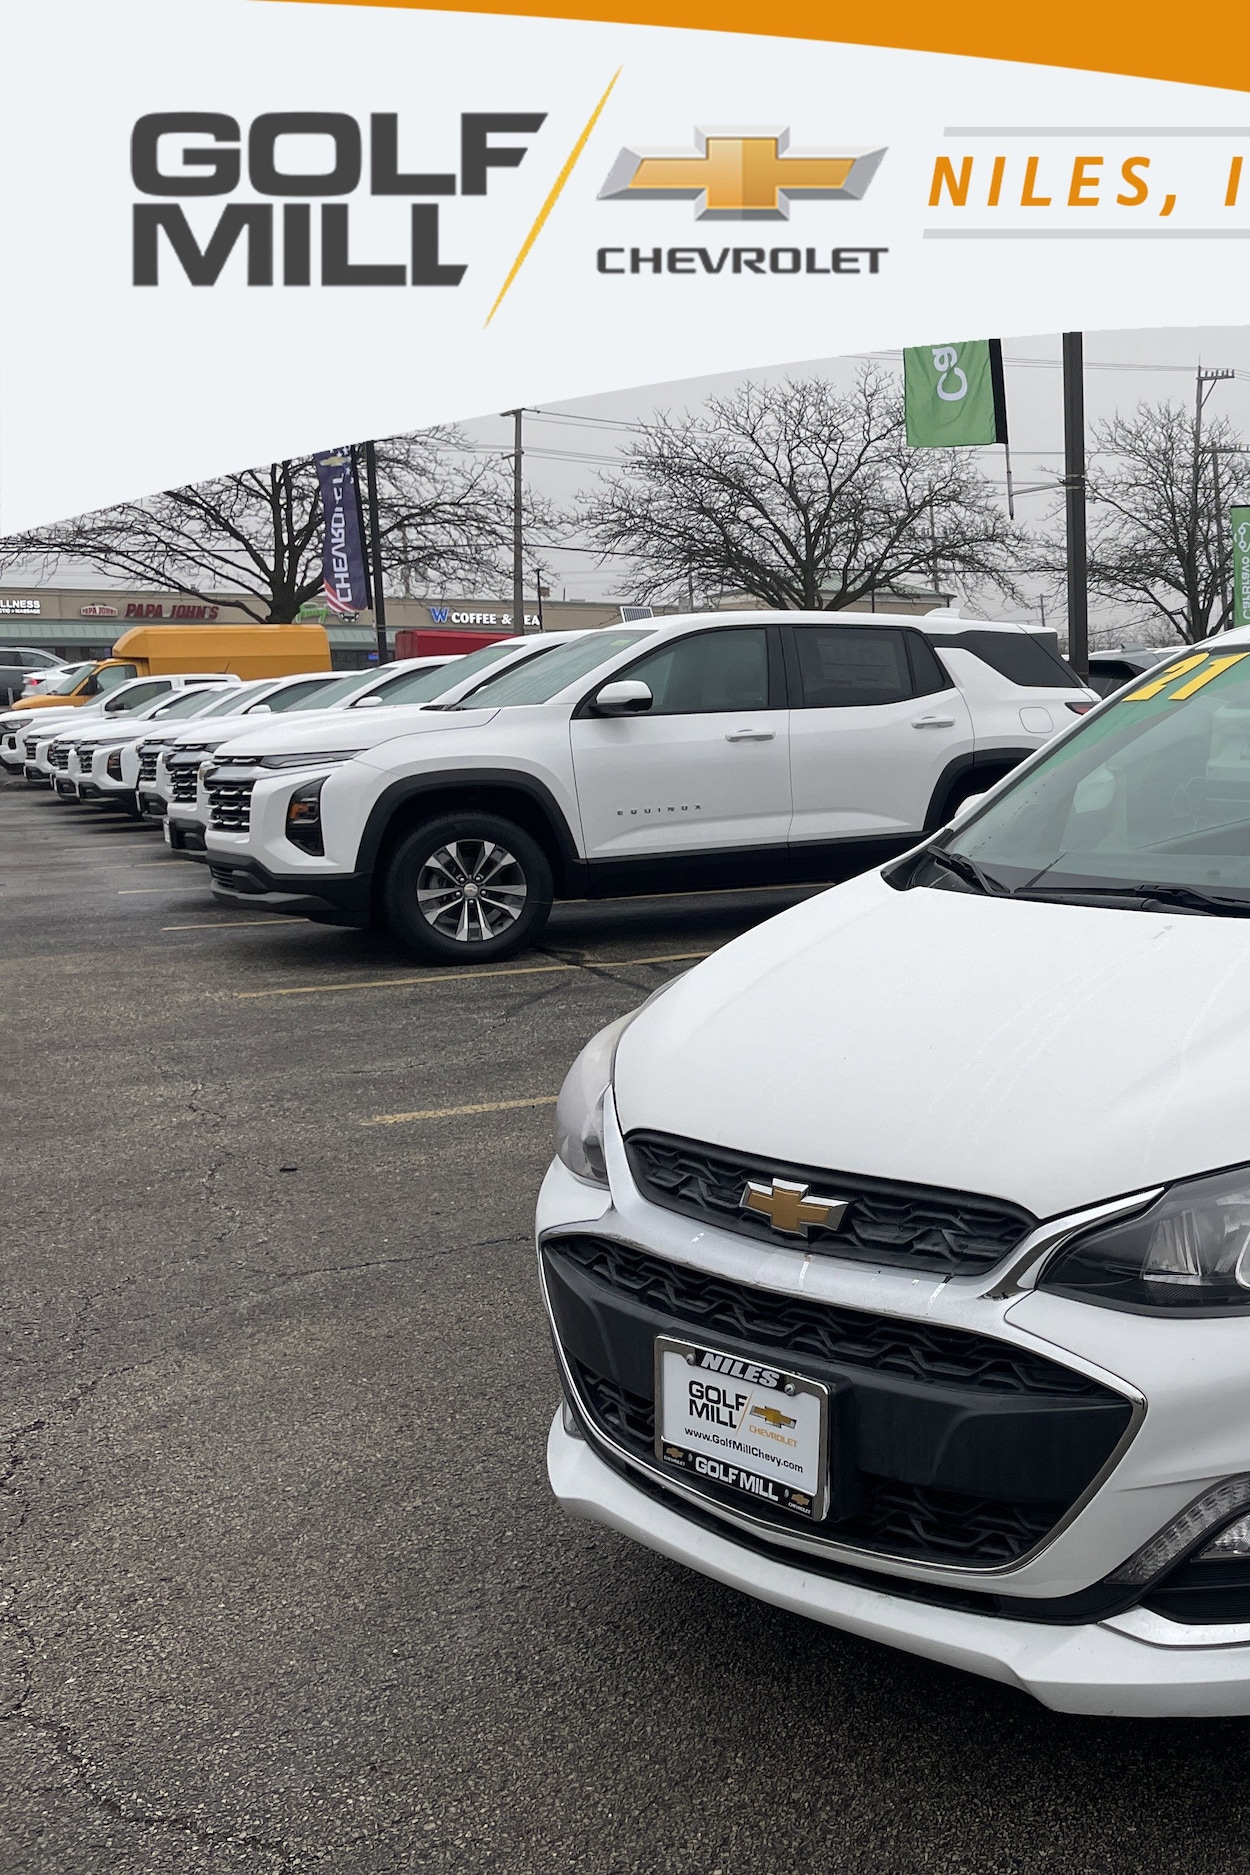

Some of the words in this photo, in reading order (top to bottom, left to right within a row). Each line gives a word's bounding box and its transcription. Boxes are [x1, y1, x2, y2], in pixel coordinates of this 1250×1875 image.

[0, 599, 41, 609] LLNESS
[125, 603, 163, 618] PAPA
[170, 605, 220, 620] JOHN'S
[430, 606, 449, 623] W
[451, 612, 497, 625] COFFEE
[501, 613, 512, 625] &
[523, 614, 542, 626] EA
[617, 804, 702, 816] EQUINOX
[701, 1352, 780, 1388] NILES
[689, 1380, 748, 1412] GOLF
[689, 1399, 738, 1429] MILL
[749, 1425, 799, 1448] CHEVROLET
[684, 1426, 804, 1474] www.GolfMillChevy.com
[695, 1456, 740, 1485] GOLF
[740, 1470, 779, 1502] MILL
